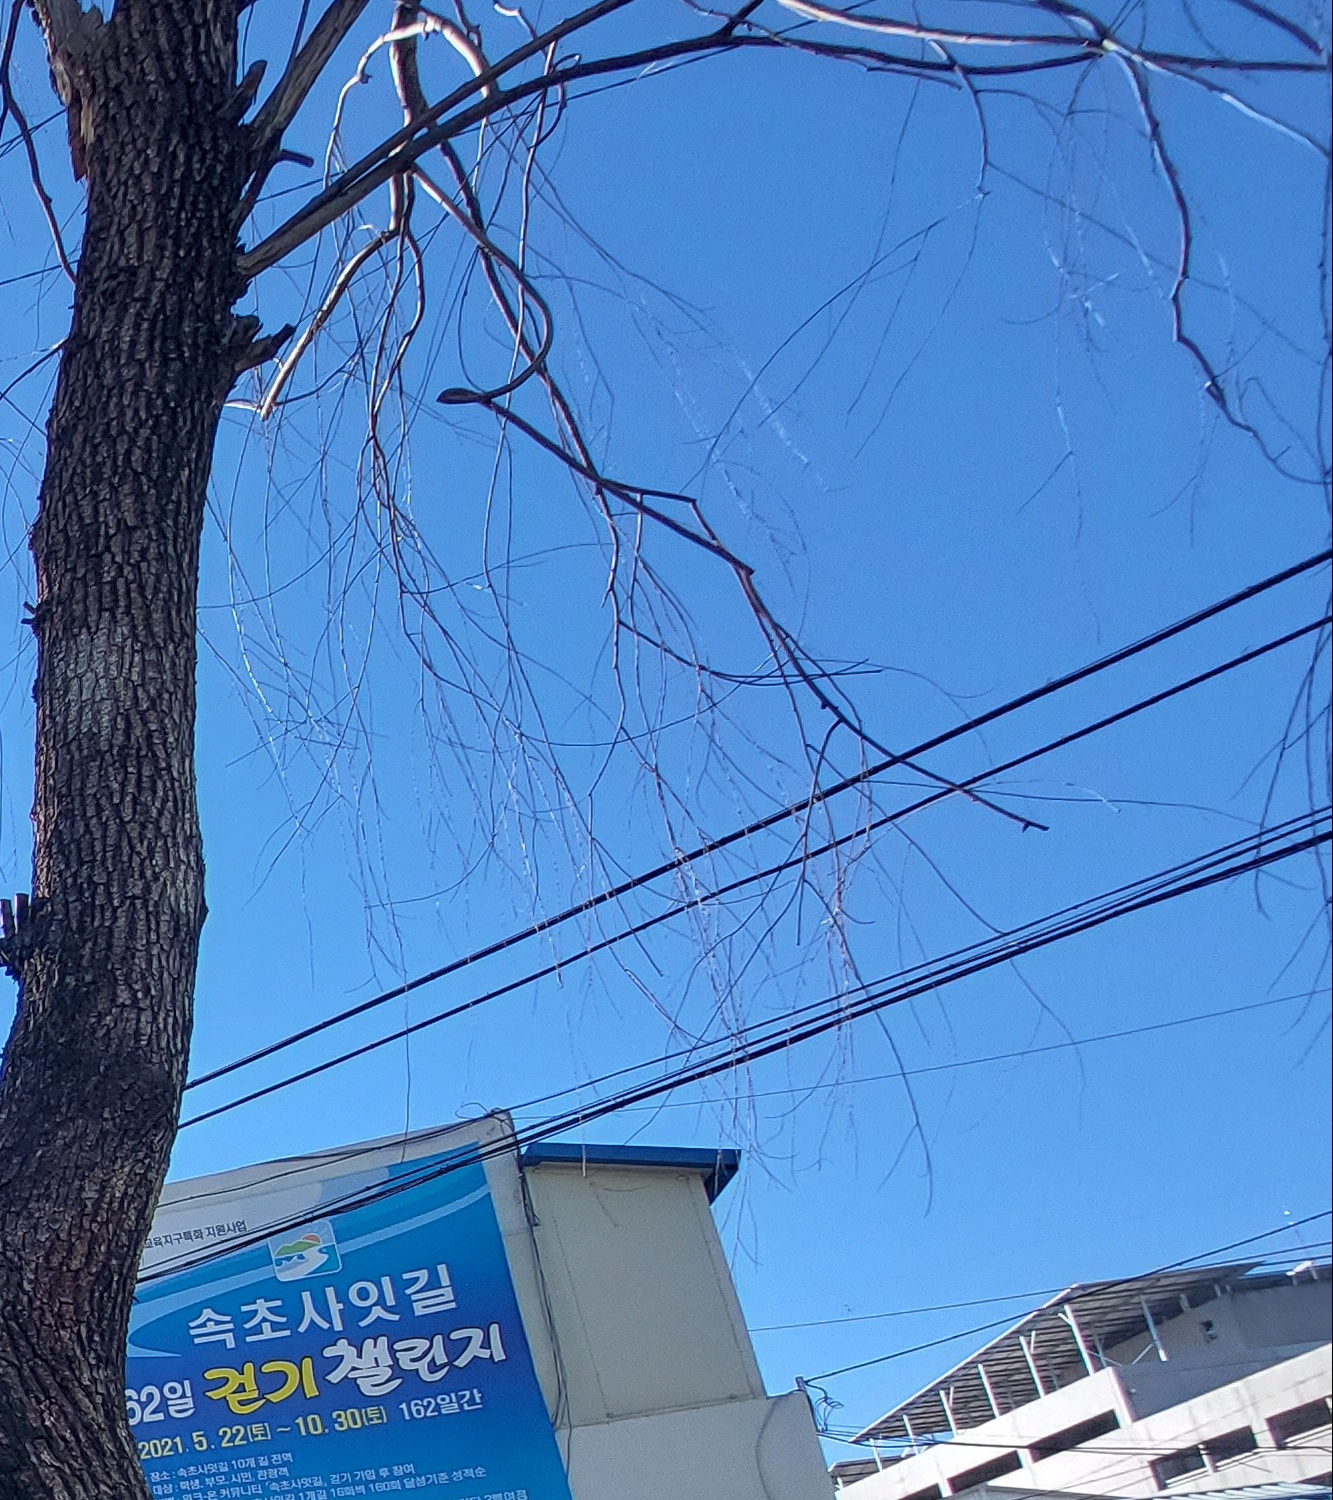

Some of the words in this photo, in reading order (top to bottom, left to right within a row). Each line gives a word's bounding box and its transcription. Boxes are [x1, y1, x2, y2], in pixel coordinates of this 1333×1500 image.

[205, 1220, 247, 1238] 지원사업
[188, 1264, 457, 1349] 속초사잇길
[125, 1380, 195, 1426] 62일
[203, 1357, 320, 1414] 걷기
[321, 1323, 507, 1398] 챌린지
[218, 1422, 271, 1448] 22(토)
[332, 1405, 388, 1432] 30(토)
[399, 1388, 483, 1421] 162일간
[177, 1461, 229, 1478] 속초사잇길
[232, 1457, 256, 1470] 10개
[257, 1466, 290, 1480] 관광객
[451, 1466, 487, 1482] 성적순
[219, 1483, 263, 1498] 커뮤니티
[330, 1472, 352, 1485] 걷기
